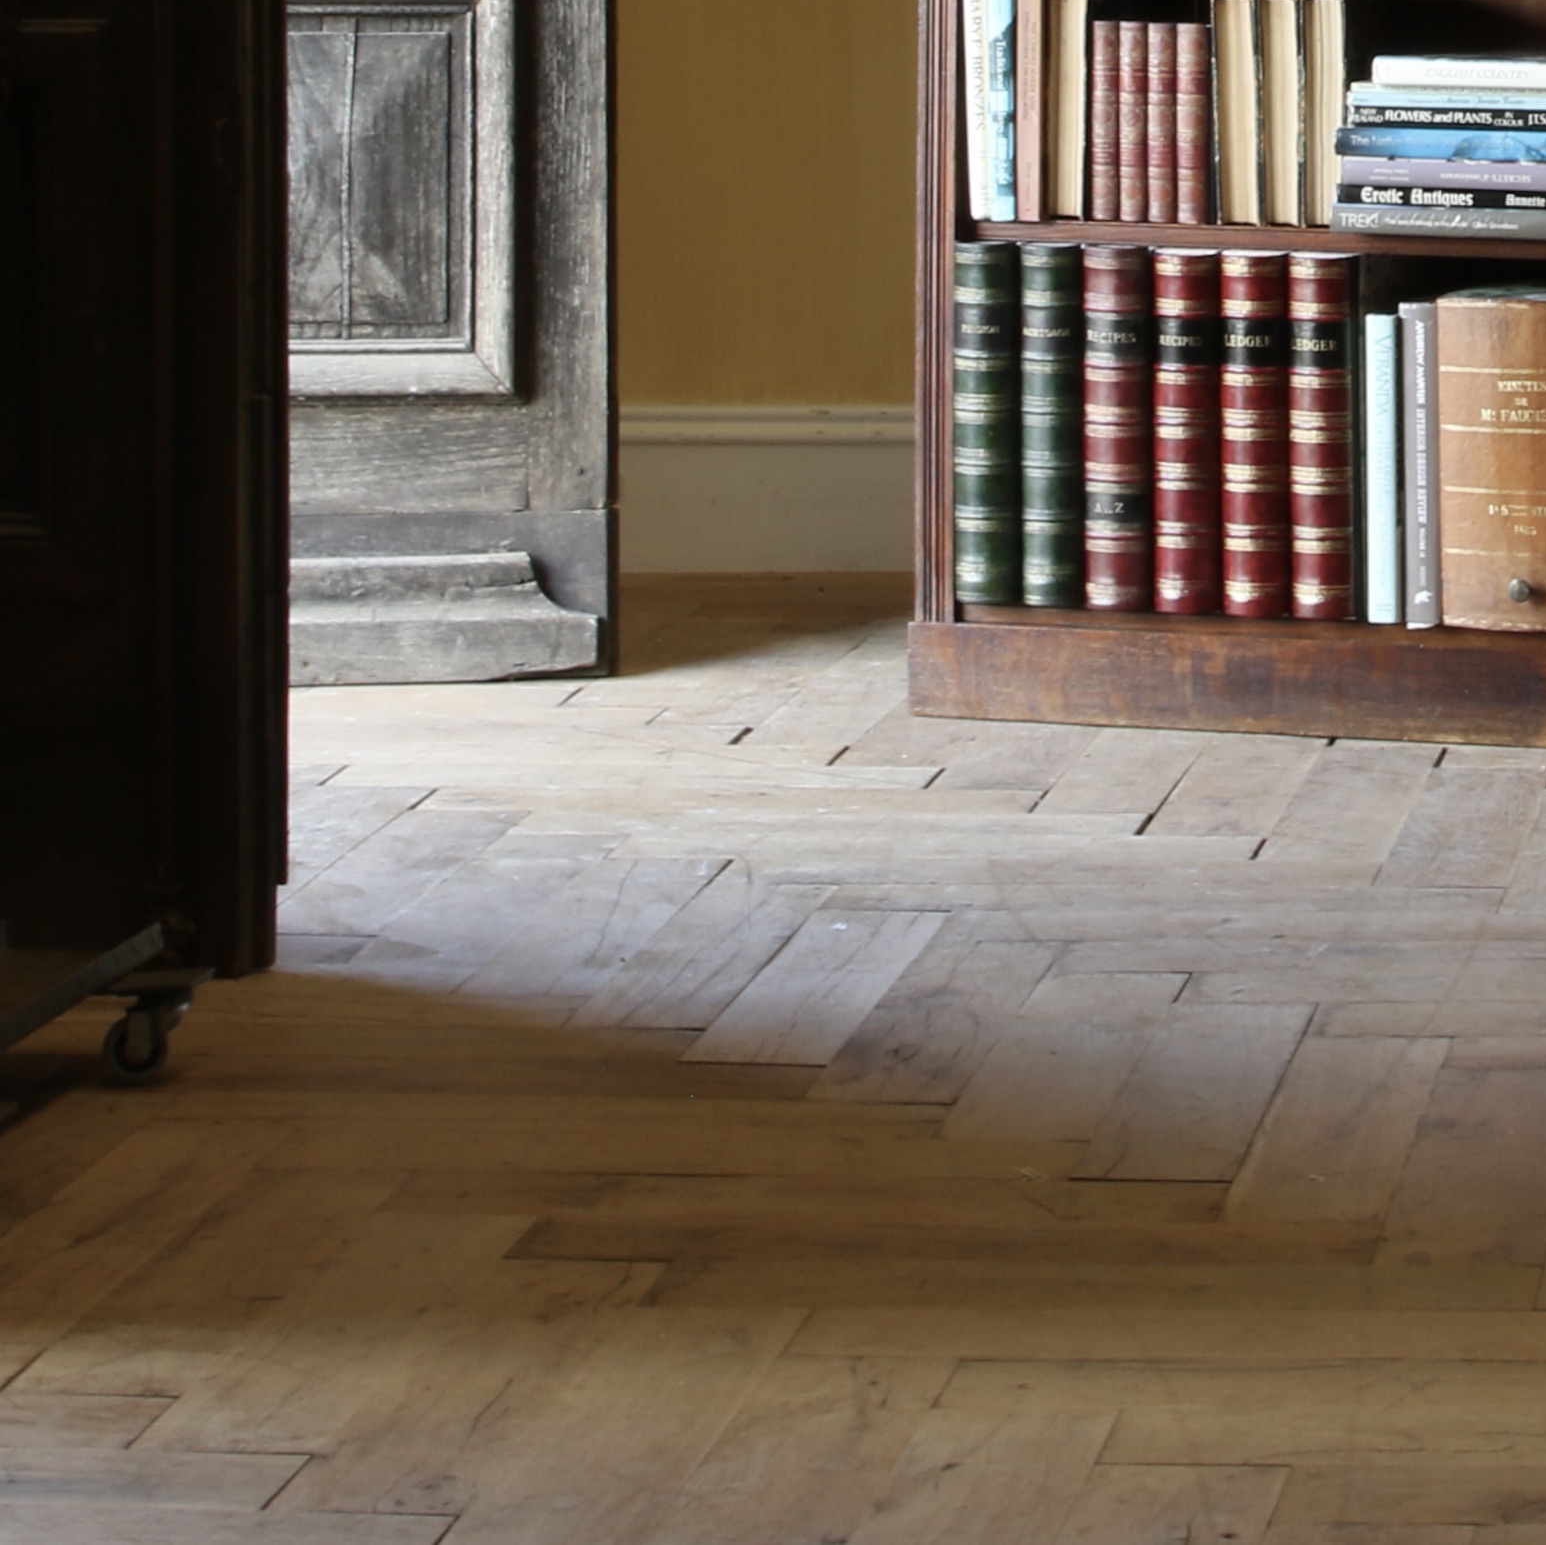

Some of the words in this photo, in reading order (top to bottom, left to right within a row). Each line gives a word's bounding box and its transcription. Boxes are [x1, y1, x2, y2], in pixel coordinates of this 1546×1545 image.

[1425, 67, 1473, 78] ENGLISH
[1477, 69, 1530, 80] COUNTRY
[972, 56, 986, 131] BRONZES
[1384, 110, 1432, 123] FLOWERS
[1433, 112, 1453, 123] and
[1454, 112, 1493, 125] PLANTS
[1494, 118, 1524, 127] COLOUR
[1350, 134, 1370, 146] The
[1492, 173, 1532, 184] SECRETS
[1361, 186, 1403, 204] Erotic
[1410, 188, 1474, 208] Antiques
[1505, 193, 1546, 208] Annette
[1086, 329, 1137, 344] RECIPES
[1224, 334, 1271, 348] LEDGER
[1415, 320, 1426, 365] ANDREW
[1291, 337, 1338, 352] LEDGER
[1375, 334, 1393, 417] VERANDA
[1416, 408, 1427, 451] INTERIOR
[1417, 488, 1427, 524] REVIEW
